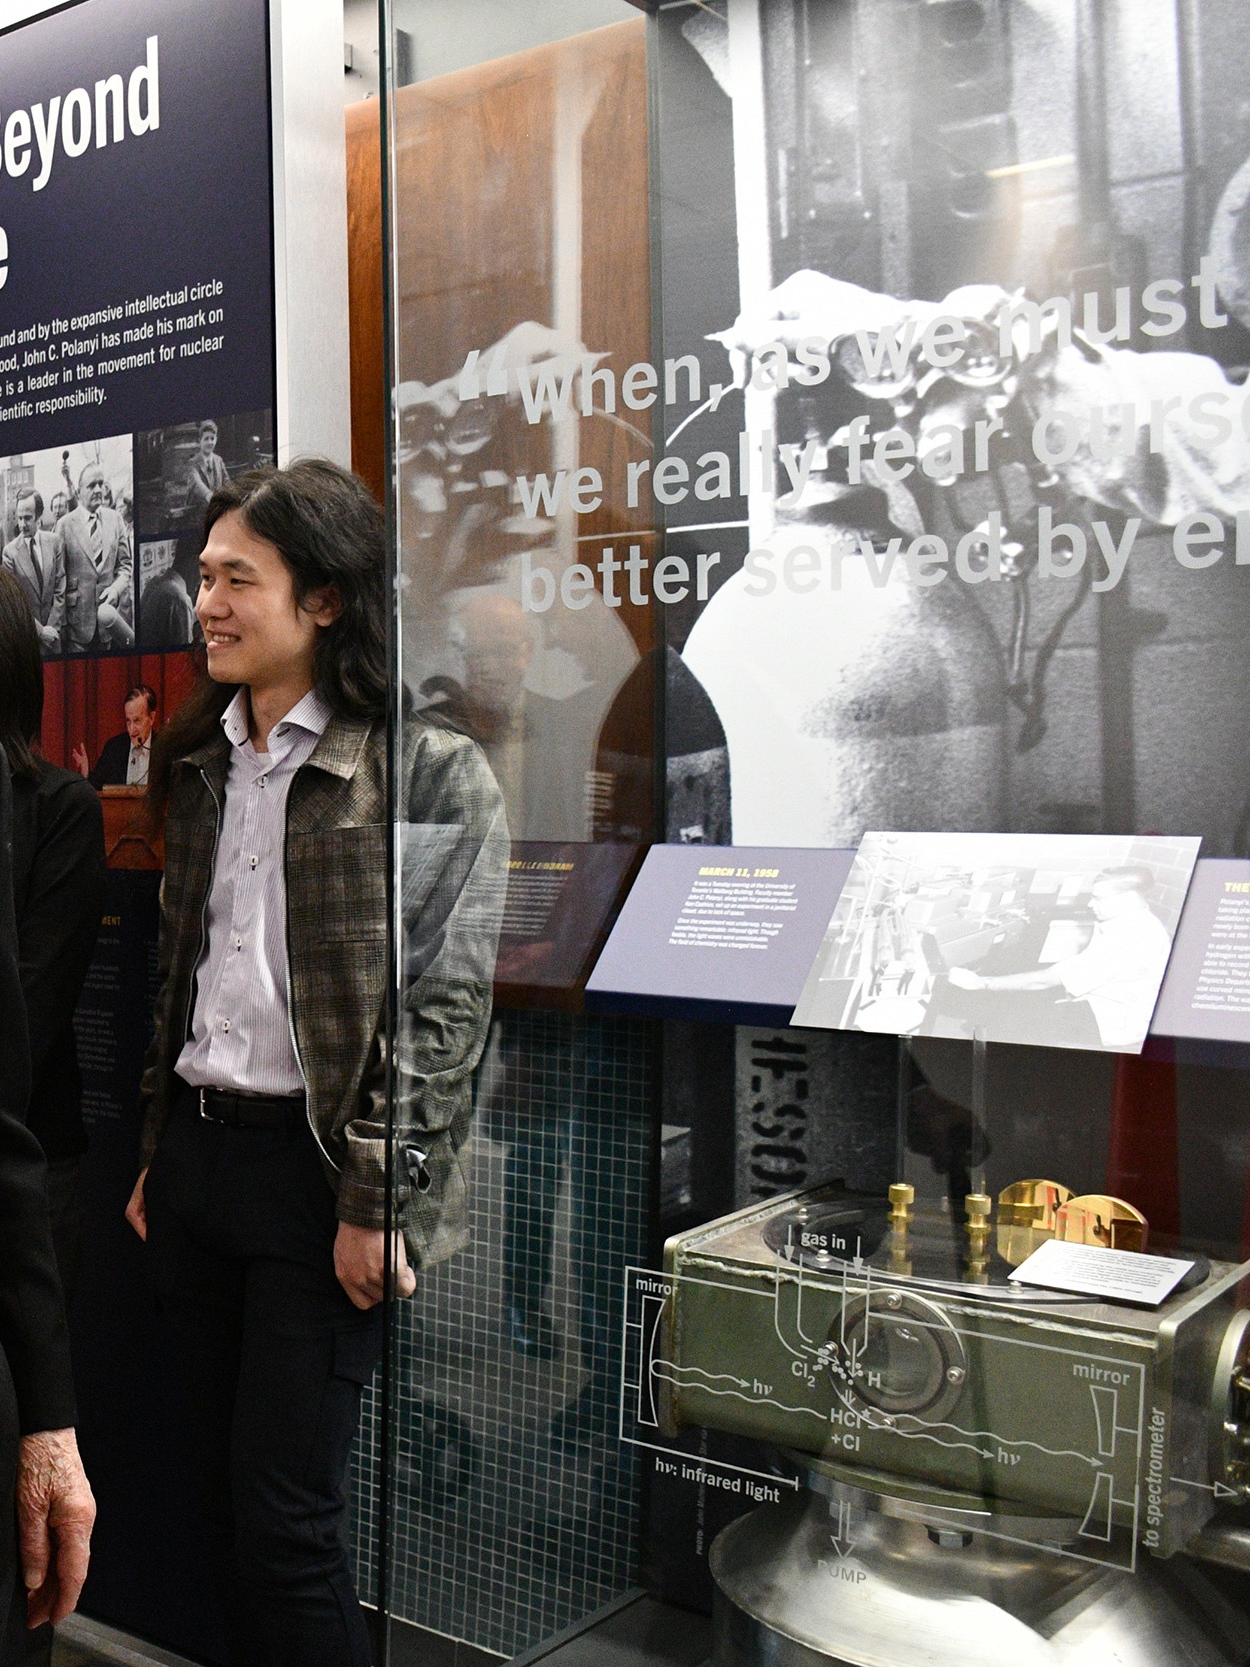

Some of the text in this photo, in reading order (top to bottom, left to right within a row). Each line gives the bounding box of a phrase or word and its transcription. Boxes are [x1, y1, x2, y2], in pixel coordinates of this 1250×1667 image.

[17, 324, 36, 344] and
[38, 323, 51, 341] by
[52, 318, 69, 335] the
[70, 305, 124, 331] expansive
[125, 286, 188, 317] intellectual
[190, 279, 224, 301] circle
[751, 334, 832, 392] as
[855, 315, 966, 380] we
[999, 255, 1228, 358] must
[22, 349, 47, 368] John
[48, 344, 59, 361] C.
[62, 334, 99, 358] Polanyi
[101, 332, 121, 349] has
[123, 322, 154, 344] made
[156, 317, 174, 336] his
[176, 309, 206, 331] mark
[208, 308, 224, 324] on
[5, 380, 15, 396] is
[17, 380, 24, 393] a
[27, 371, 60, 391] leader
[63, 367, 73, 383] in
[76, 363, 94, 379] the
[98, 347, 155, 376] movement
[159, 344, 176, 362] for
[180, 335, 225, 358] nuclear
[35, 387, 107, 414] responsibility.
[516, 391, 1250, 519] we really fear ours
[521, 545, 721, 613] better
[743, 511, 1001, 597] served
[1038, 505, 1143, 593] by
[698, 866, 780, 878] MARCH 11, 1958
[1225, 882, 1250, 893] THE
[801, 1230, 846, 1250] gas in
[636, 1278, 678, 1296] mirror
[868, 1372, 881, 1389] H
[1072, 1362, 1131, 1386] mirror
[681, 1464, 741, 1493] infrared
[745, 1481, 781, 1503] light
[1142, 1407, 1166, 1548] to spectrometer
